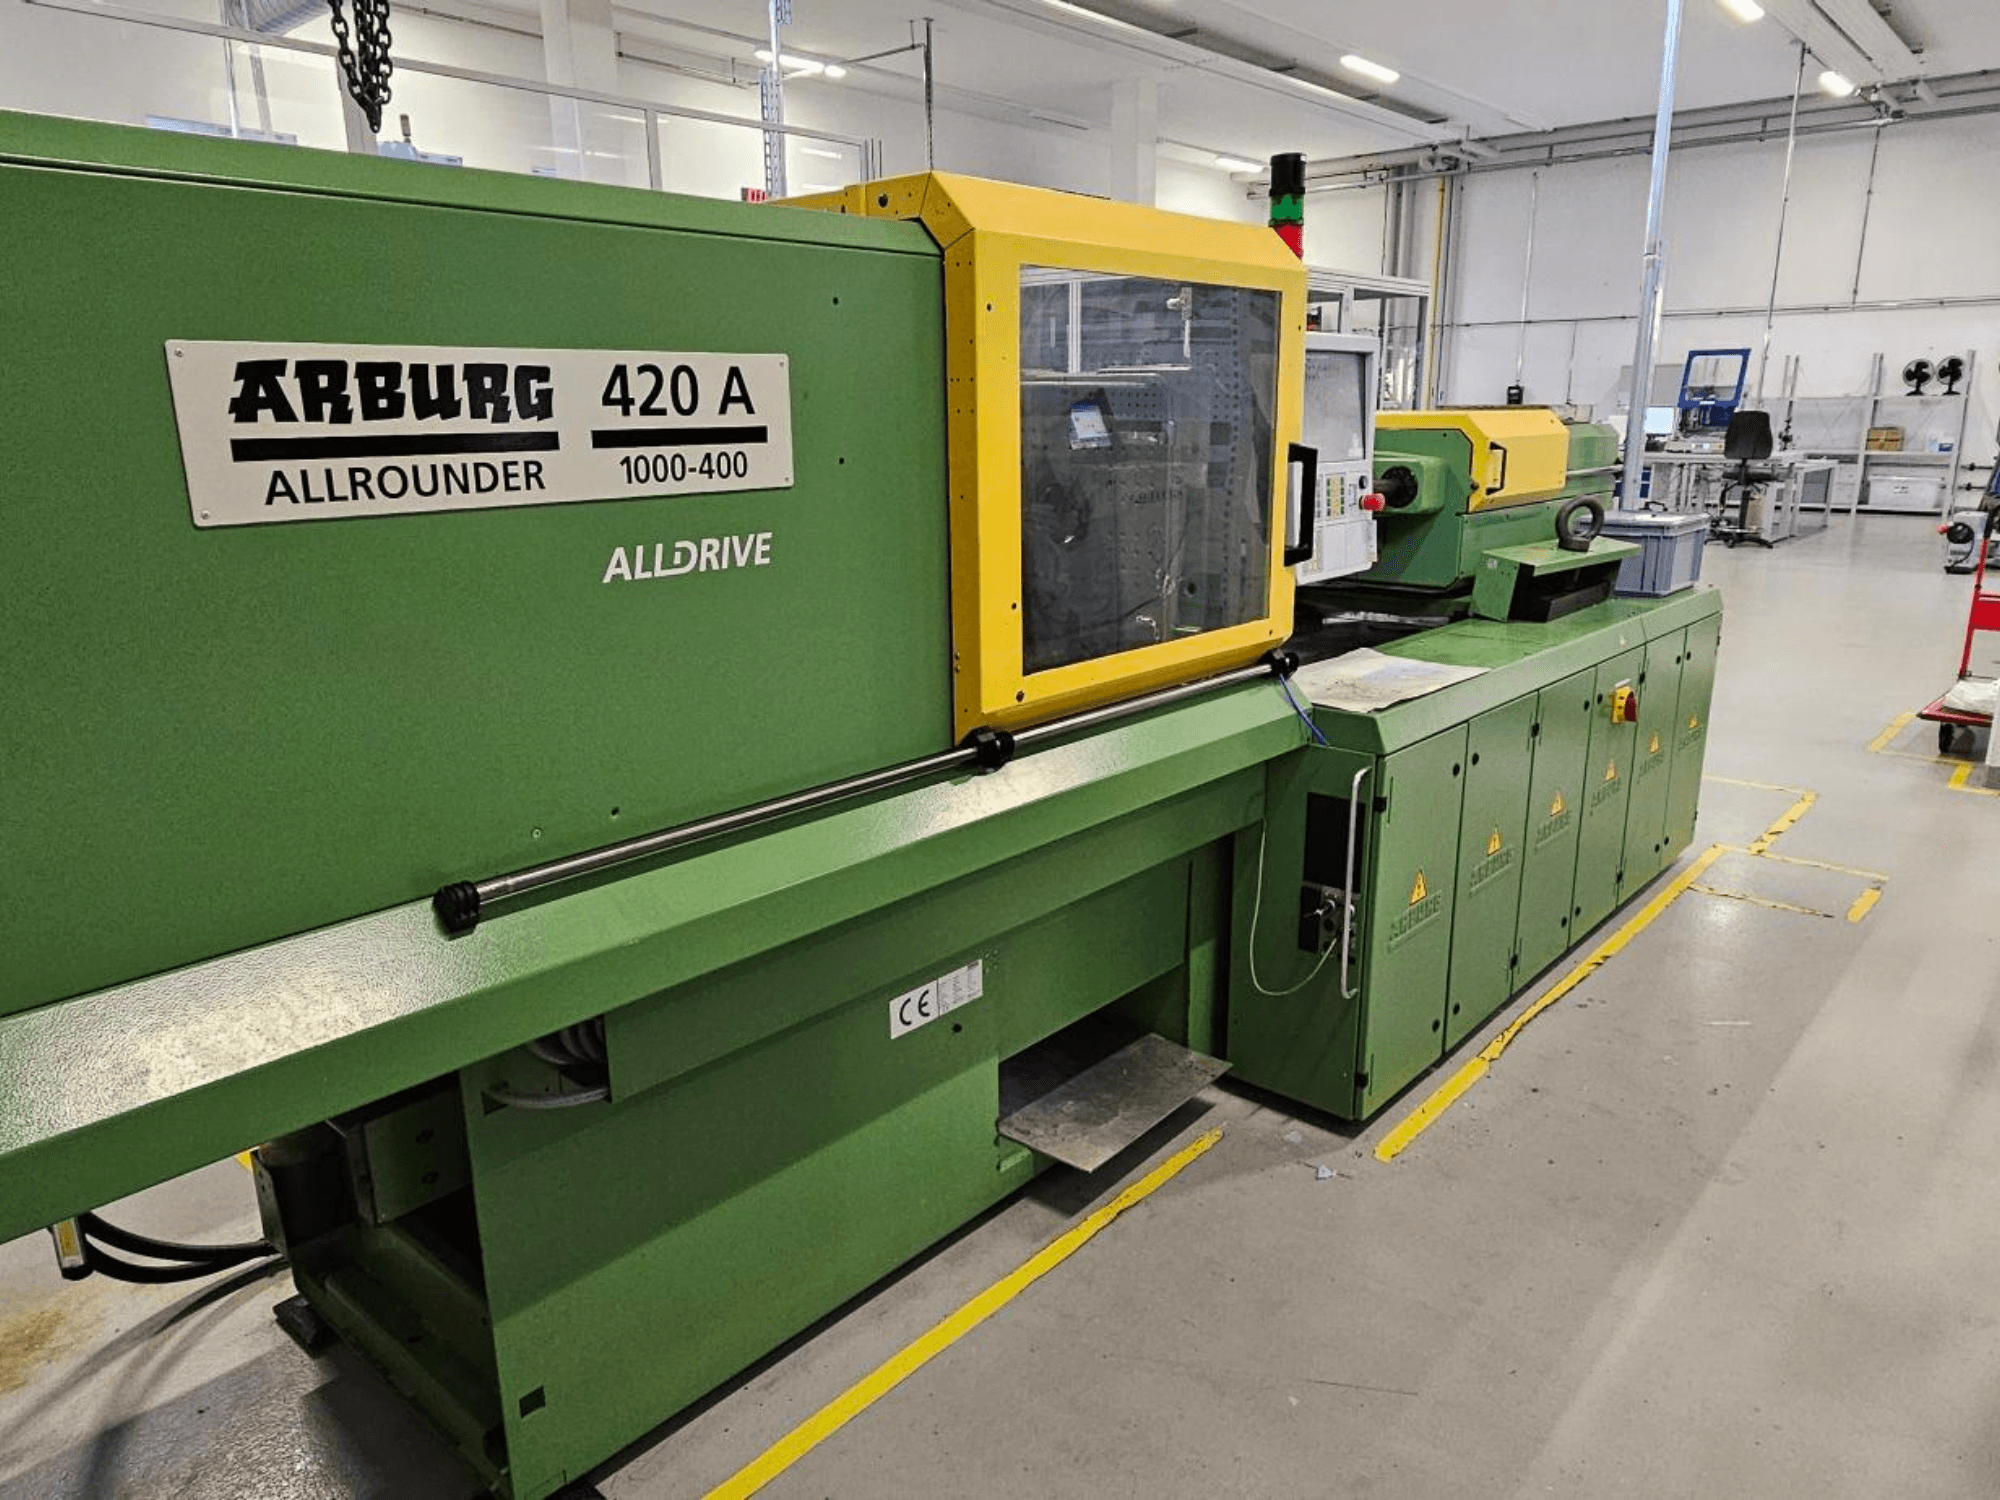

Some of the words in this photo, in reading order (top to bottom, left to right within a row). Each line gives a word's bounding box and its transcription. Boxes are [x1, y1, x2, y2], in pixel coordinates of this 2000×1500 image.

[228, 358, 554, 425] ARBURG
[602, 364, 699, 417] 420
[718, 366, 756, 415] A
[265, 460, 546, 506] ALLROUNDER
[619, 450, 748, 485] 1000-400
[603, 532, 773, 584] ALLDRIVE
[899, 990, 931, 1026] CE
